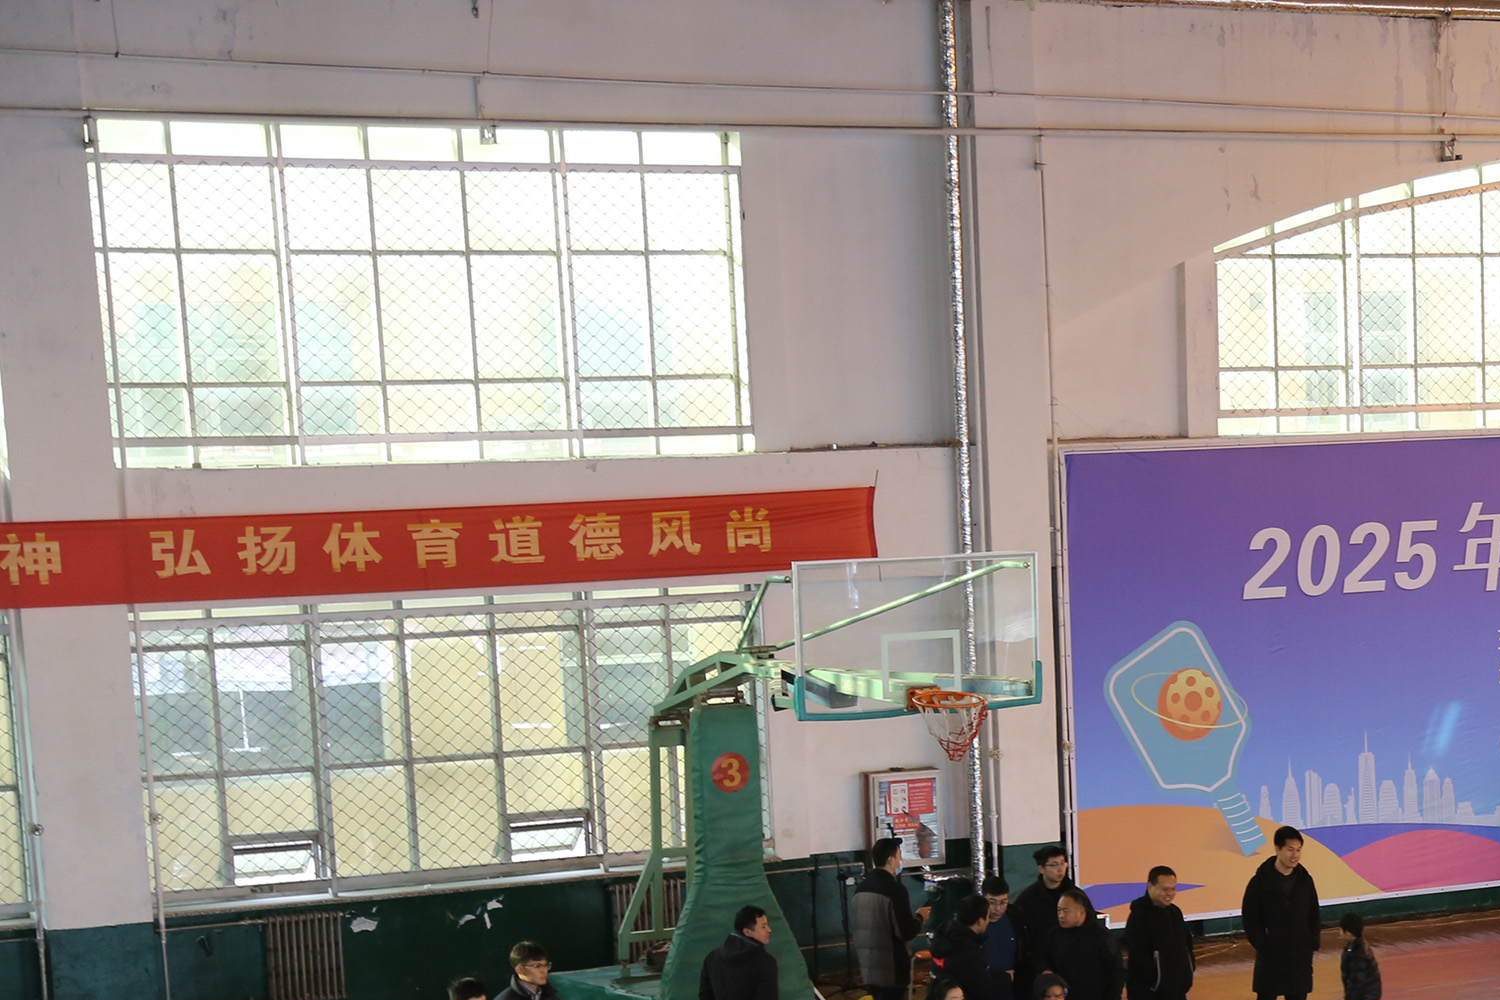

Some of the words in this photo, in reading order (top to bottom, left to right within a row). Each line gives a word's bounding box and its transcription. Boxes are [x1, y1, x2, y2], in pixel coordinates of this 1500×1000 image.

[0, 533, 62, 585] 神
[149, 507, 773, 579] 弘扬体育道德风尚
[720, 757, 740, 787] 3
